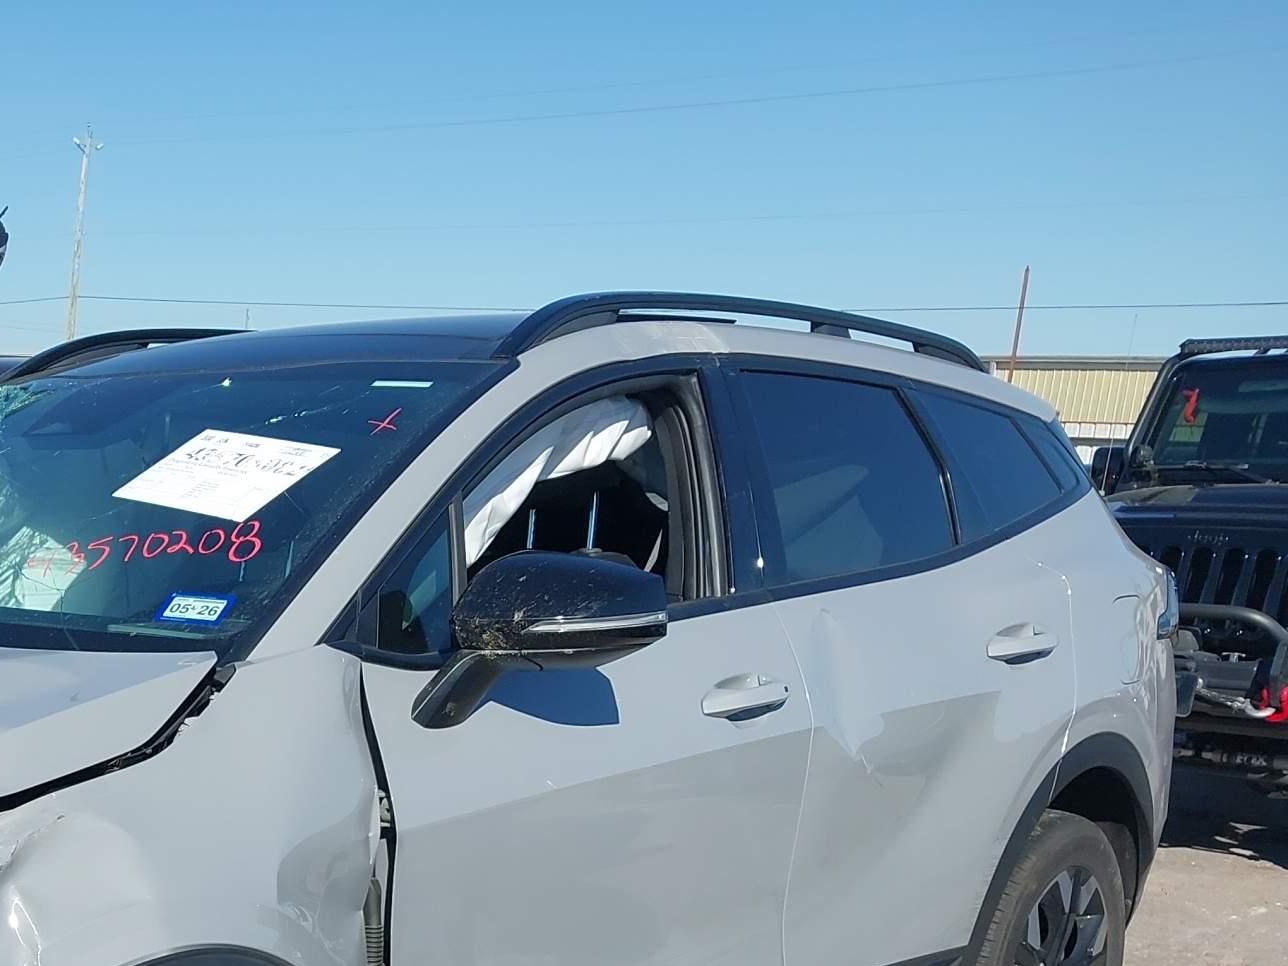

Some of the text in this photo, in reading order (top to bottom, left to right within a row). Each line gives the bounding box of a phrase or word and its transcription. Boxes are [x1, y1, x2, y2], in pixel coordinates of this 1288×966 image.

[26, 519, 263, 577] 43570208
[169, 602, 220, 617] 05 26
